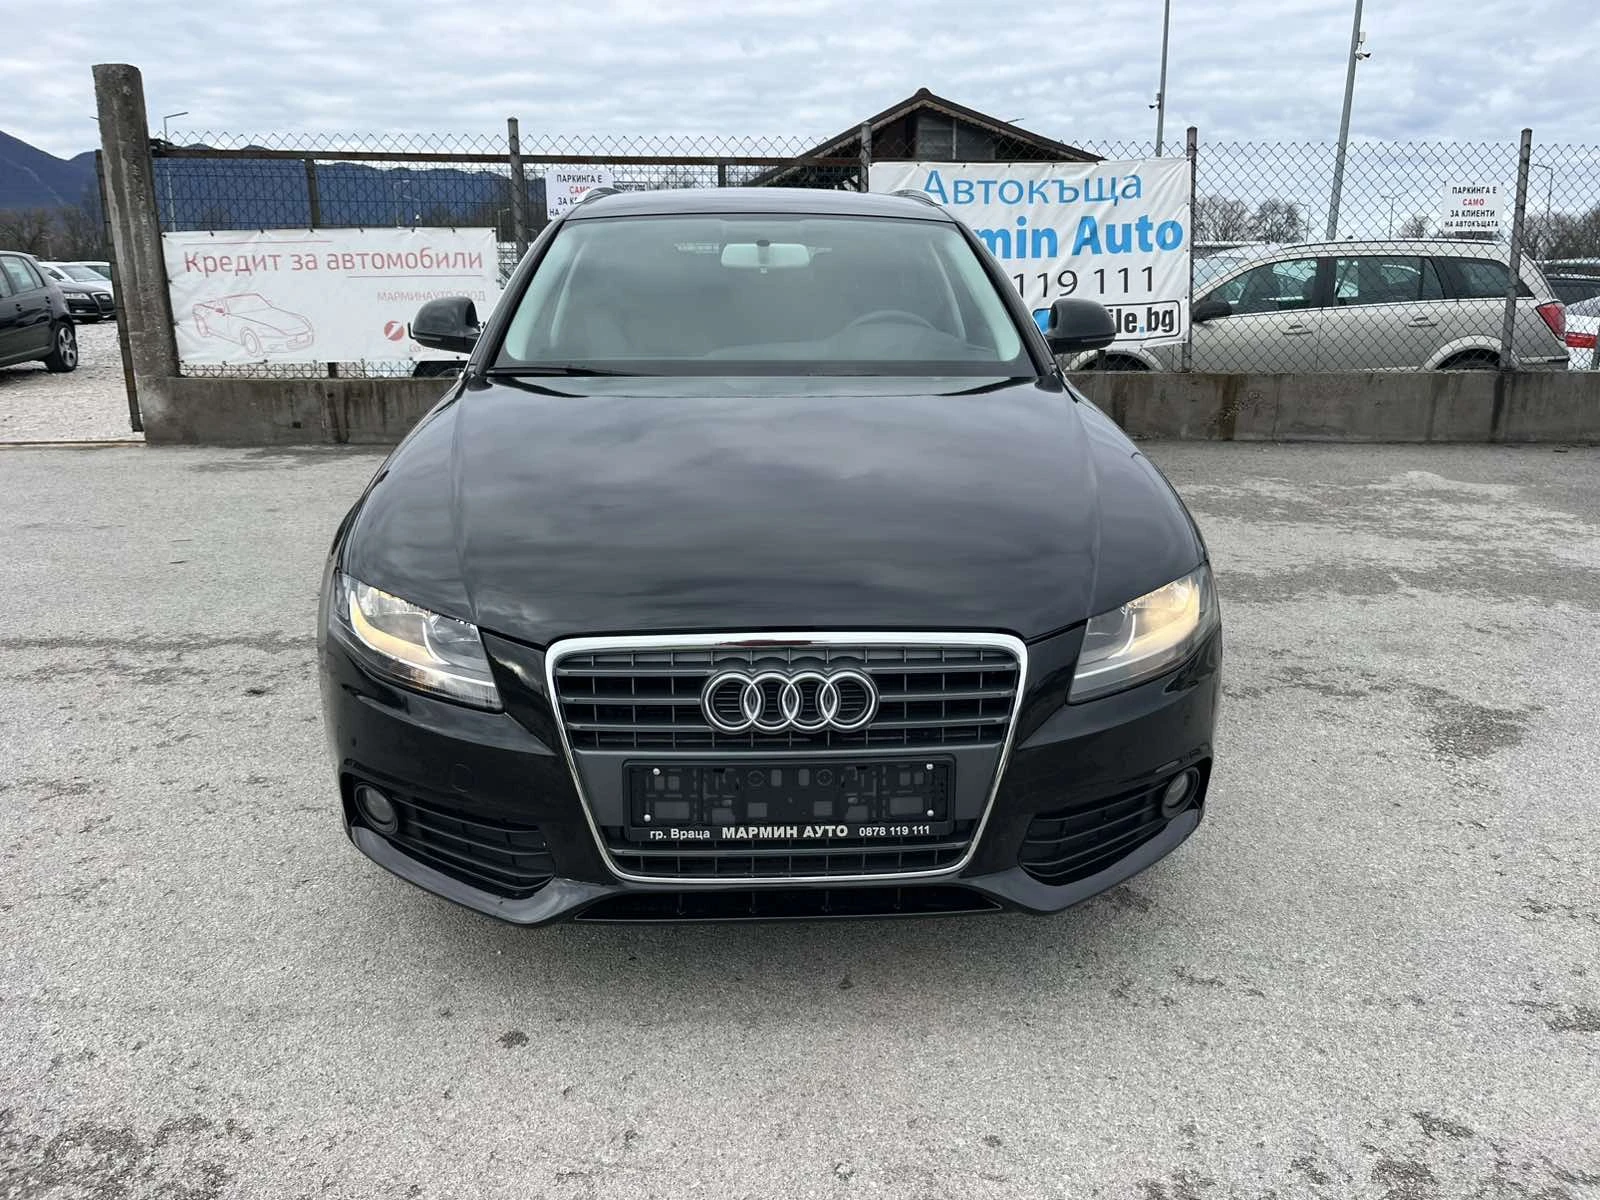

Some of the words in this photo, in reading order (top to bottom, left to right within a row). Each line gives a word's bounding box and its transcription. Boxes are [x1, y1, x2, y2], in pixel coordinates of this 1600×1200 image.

[556, 174, 596, 183] ПАРКИНГА
[597, 175, 603, 183] Е
[923, 169, 1142, 207] Автокъща
[1452, 186, 1491, 194] ПАРКИНГА
[1492, 186, 1497, 194] Е
[557, 197, 568, 206] ЗА
[1463, 198, 1485, 206] САМО
[549, 208, 560, 216] НА
[1461, 209, 1495, 217] КЛИЕНТИ
[1455, 220, 1499, 228] АВТОКЪЩАТА
[973, 215, 1059, 259] min
[1071, 214, 1184, 257] Auto
[184, 251, 282, 277] Кредит
[291, 254, 318, 271] за
[327, 247, 483, 271] автомобили
[1013, 269, 1078, 298] 119
[1093, 266, 1154, 295] 111
[649, 829, 667, 840] гр.
[670, 828, 711, 840] Враца
[722, 826, 798, 839] МАРМИН
[802, 825, 849, 838] АУТО
[858, 826, 886, 836] 0878
[888, 826, 909, 836] 119
[912, 825, 931, 835] 111
